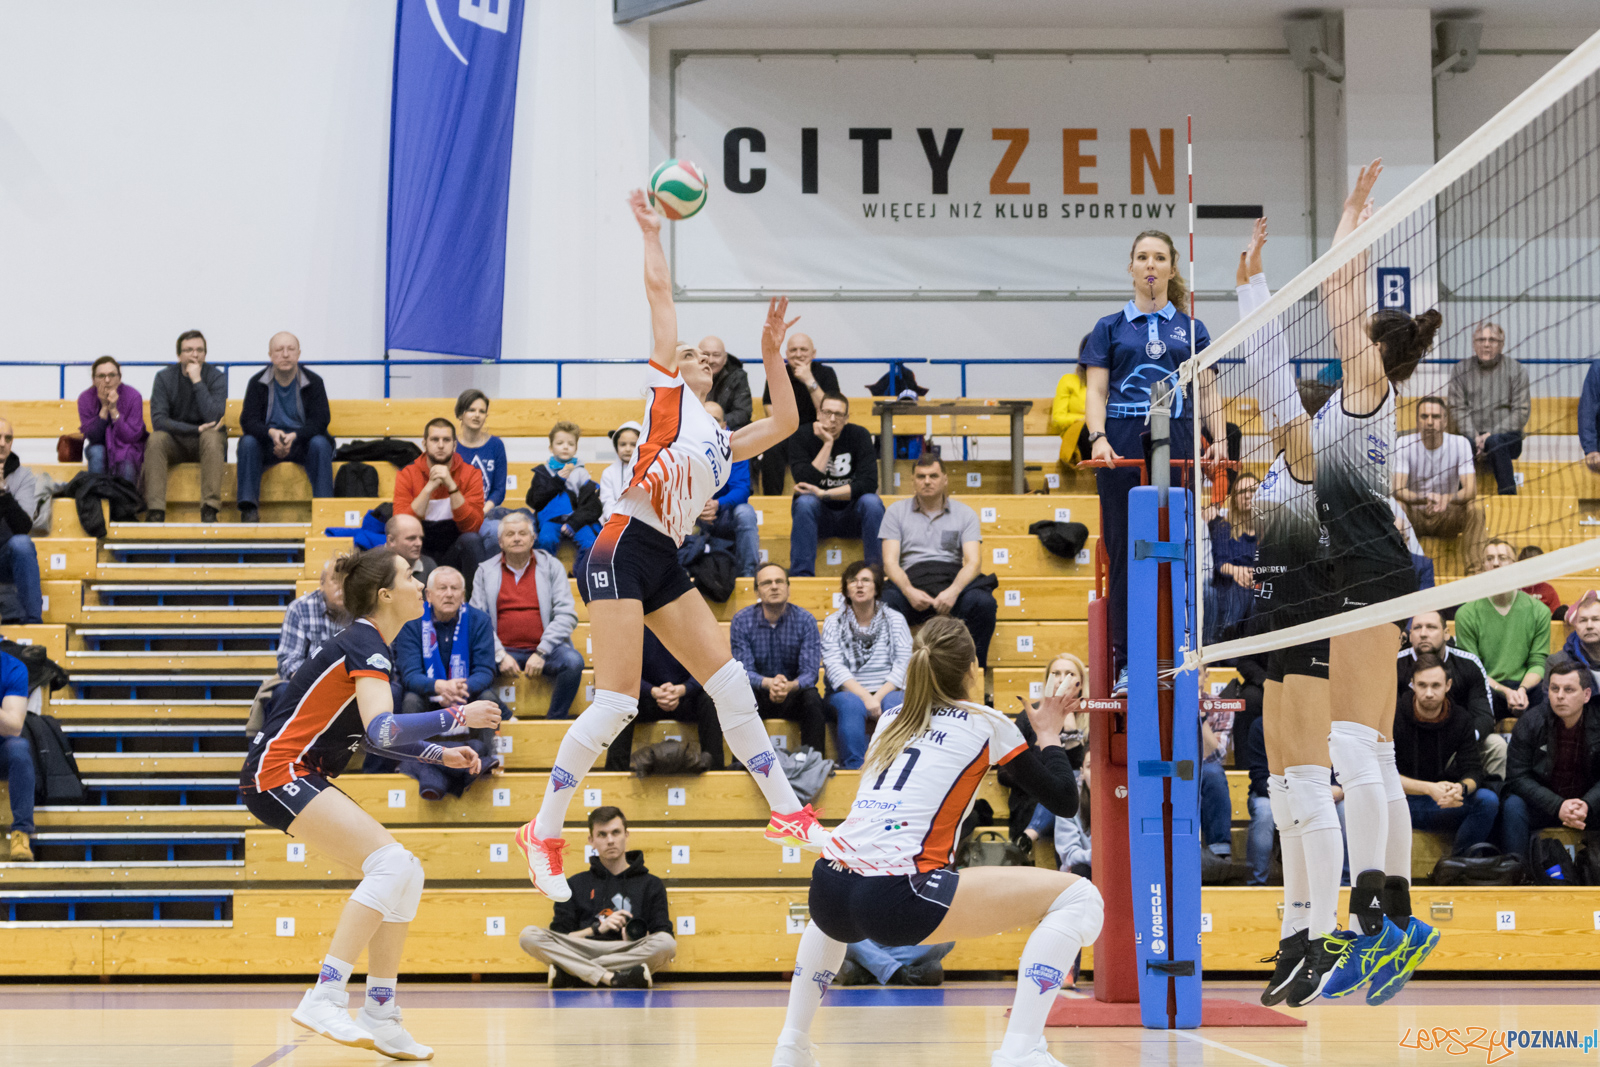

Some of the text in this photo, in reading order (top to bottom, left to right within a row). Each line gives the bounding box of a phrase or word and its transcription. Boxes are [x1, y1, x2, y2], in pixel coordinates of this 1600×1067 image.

[723, 127, 1175, 195] CITYZEN
[862, 201, 1177, 222] WIĘCEJ NIŻ KLUB SPORTOWY
[1384, 274, 1405, 308] B
[1058, 510, 1067, 518] 15
[591, 571, 609, 588] 19
[1008, 593, 1017, 601] 16
[1088, 700, 1121, 709] Senoh
[1214, 701, 1242, 709] Senoh
[283, 782, 300, 796] 8
[394, 793, 400, 802] 7
[498, 792, 505, 801] 6
[590, 792, 596, 801] 5
[673, 791, 680, 799] 4
[293, 847, 299, 855] 8
[496, 847, 502, 856] 6
[678, 849, 684, 857] 4
[788, 848, 795, 857] 3
[1150, 883, 1164, 938] Senoh
[1501, 914, 1511, 923] 12
[283, 921, 289, 930] 8
[493, 920, 499, 929] 6
[683, 919, 689, 928] 4
